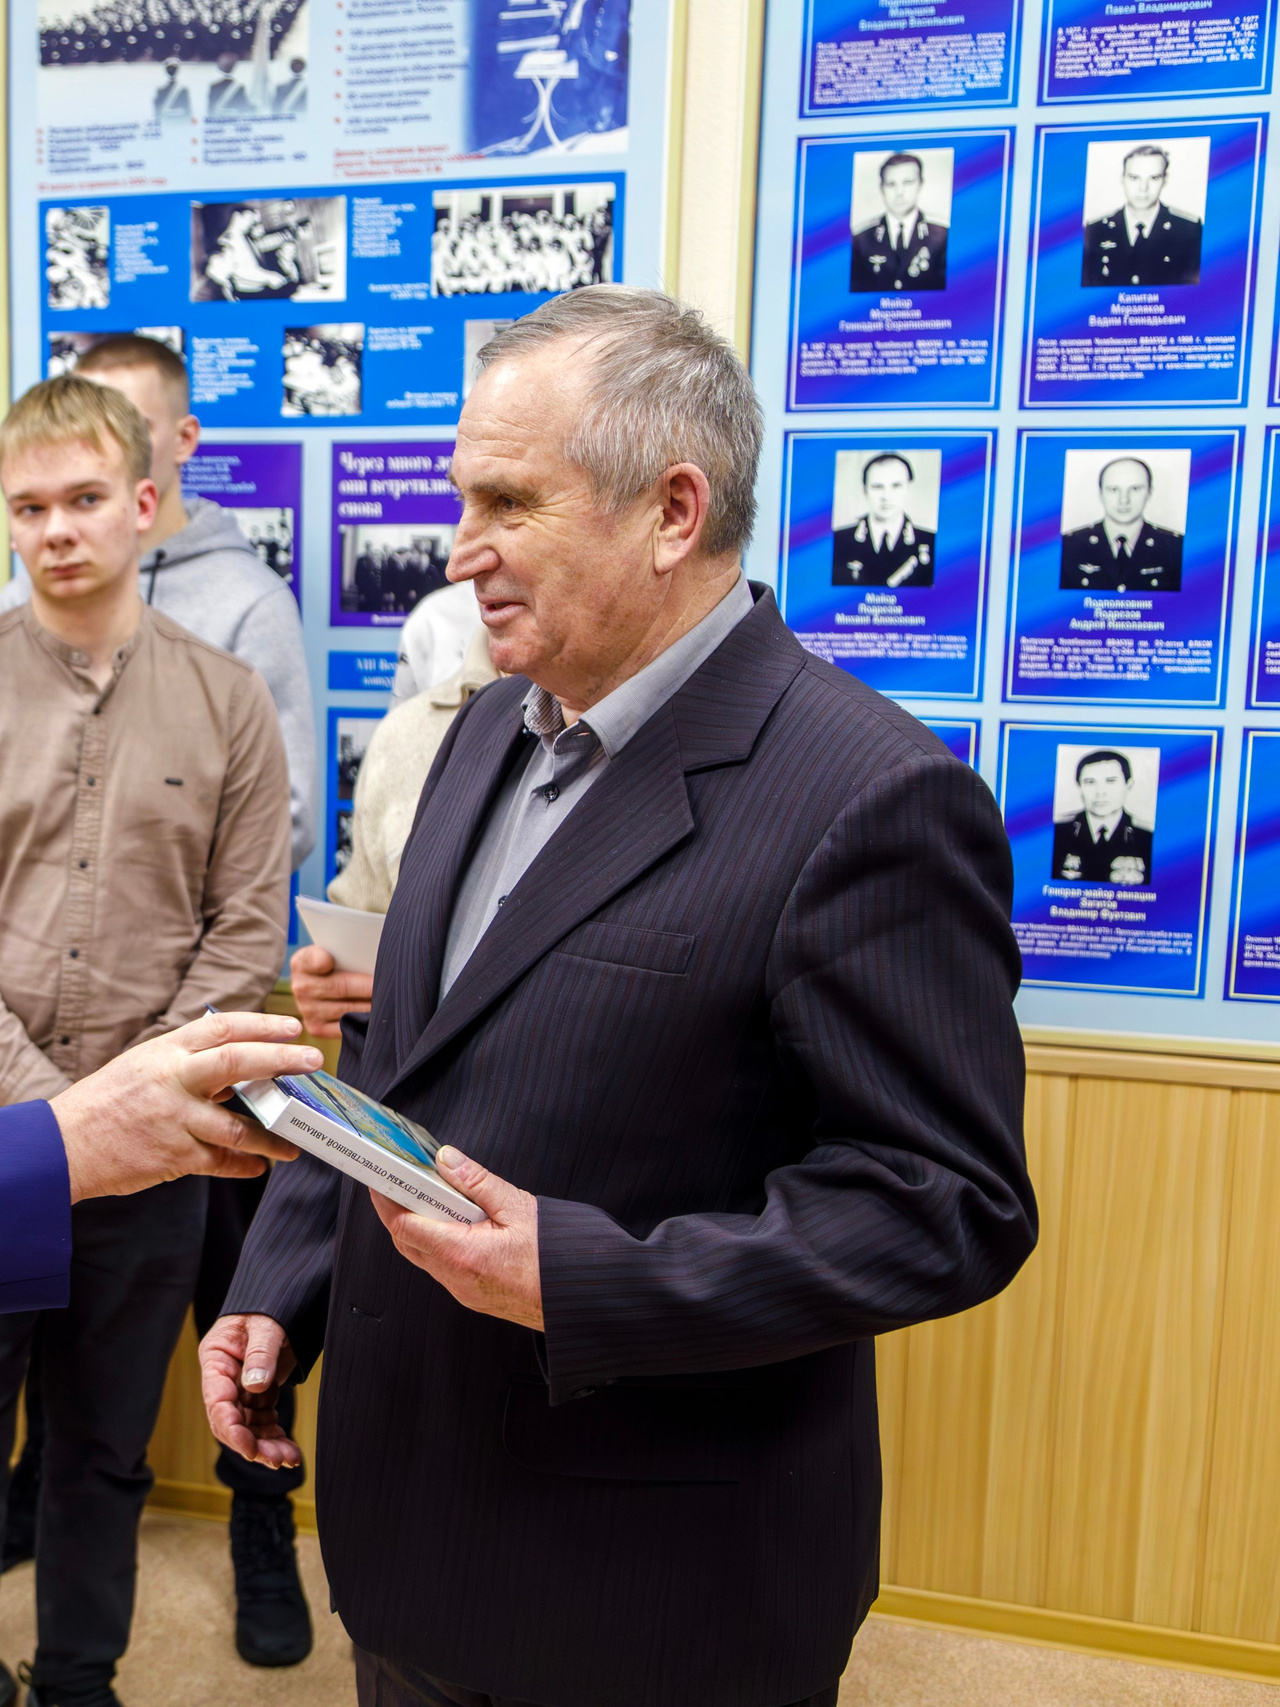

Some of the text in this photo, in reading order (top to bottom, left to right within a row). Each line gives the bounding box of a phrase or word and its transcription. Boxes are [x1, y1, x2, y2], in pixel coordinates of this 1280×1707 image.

[1105, 0, 1212, 15] Павел Владимирович
[880, 297, 912, 309] Майор
[1118, 292, 1159, 303] Капитан
[1089, 315, 1185, 327] Вадим Геннадьевич
[339, 451, 384, 477] Через
[865, 592, 897, 605] Майор
[1084, 597, 1153, 609] Подполковник
[1069, 618, 1165, 631] Андрей Николаевич
[1042, 885, 1157, 902] Генерал-майор авиации
[1050, 905, 1098, 919] Владимир
[290, 1117, 327, 1141] АВИАЦИИ
[327, 1138, 388, 1177] ОТЕЧЕСТВЕННОЙ
[387, 1173, 419, 1194] СЛУЖБЫ
